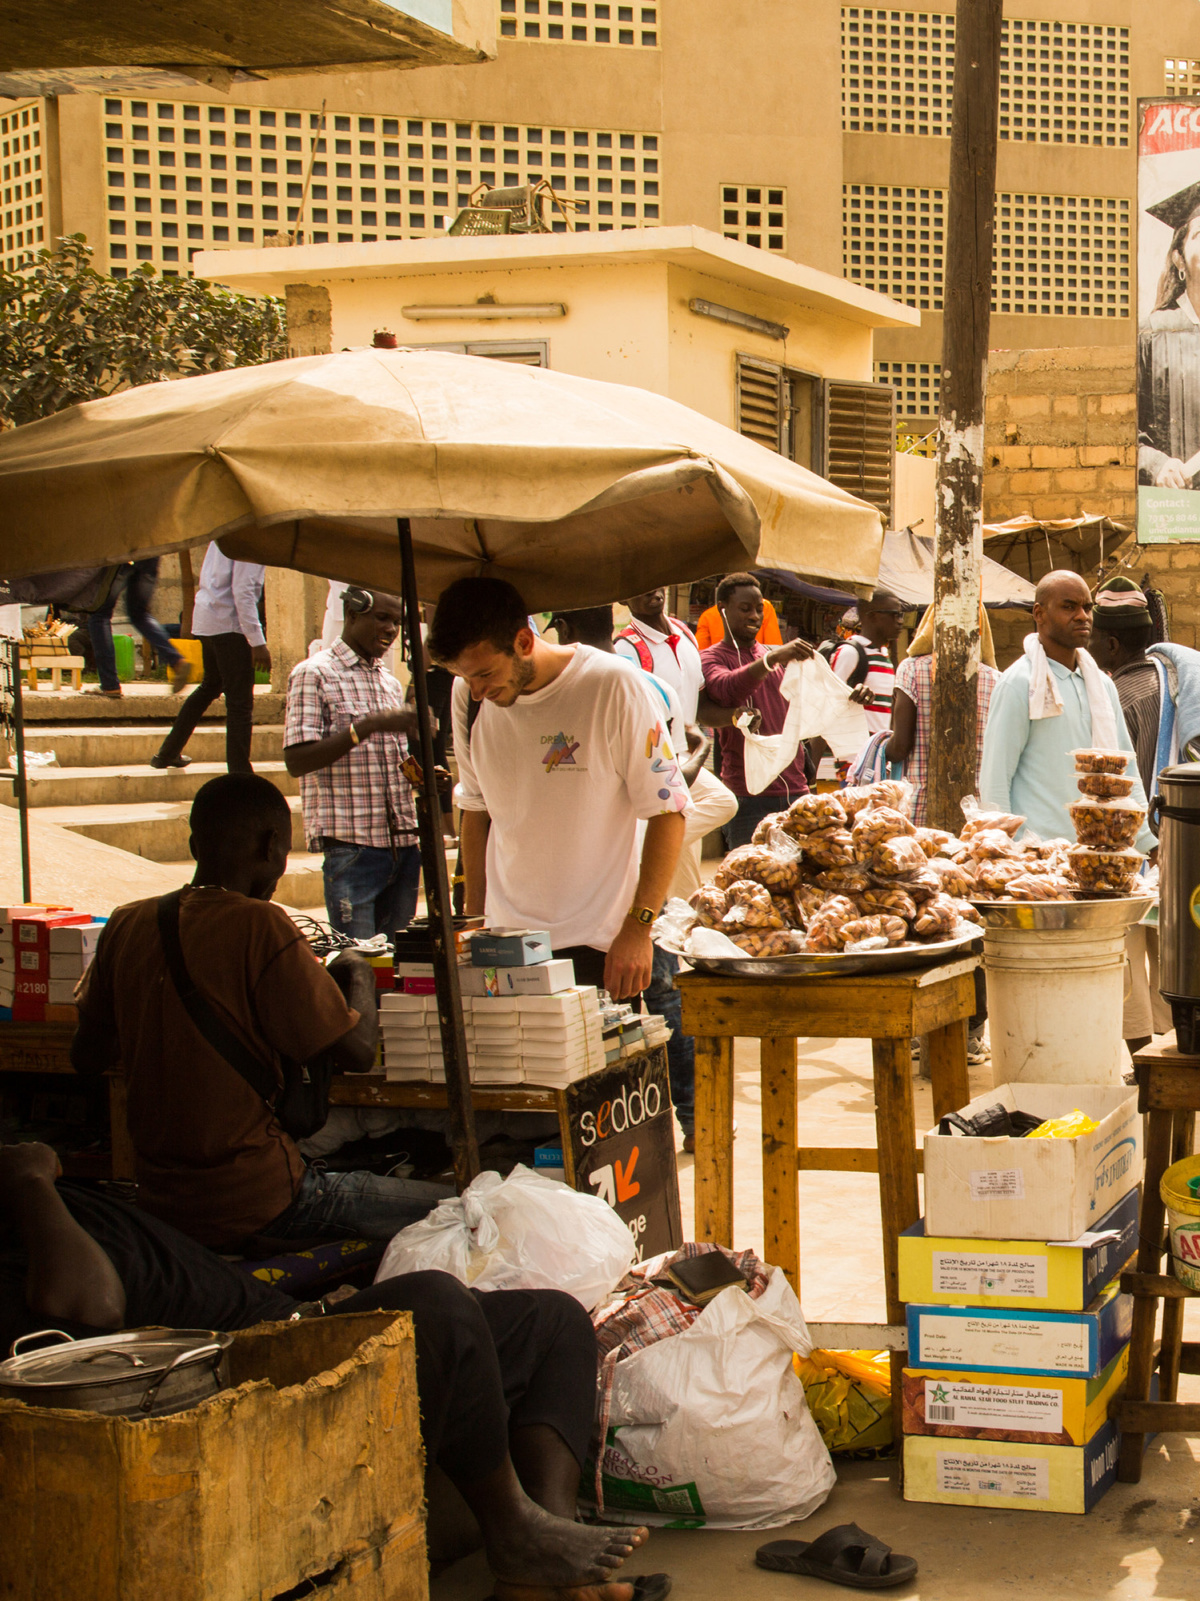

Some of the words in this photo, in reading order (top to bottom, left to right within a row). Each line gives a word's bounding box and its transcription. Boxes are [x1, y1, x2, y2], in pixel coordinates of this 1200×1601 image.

[1146, 498, 1185, 508] Contact
[1175, 513, 1186, 522] 80
[1187, 513, 1198, 522] 46
[540, 734, 575, 745] DREAM
[579, 1077, 661, 1147] seddo
